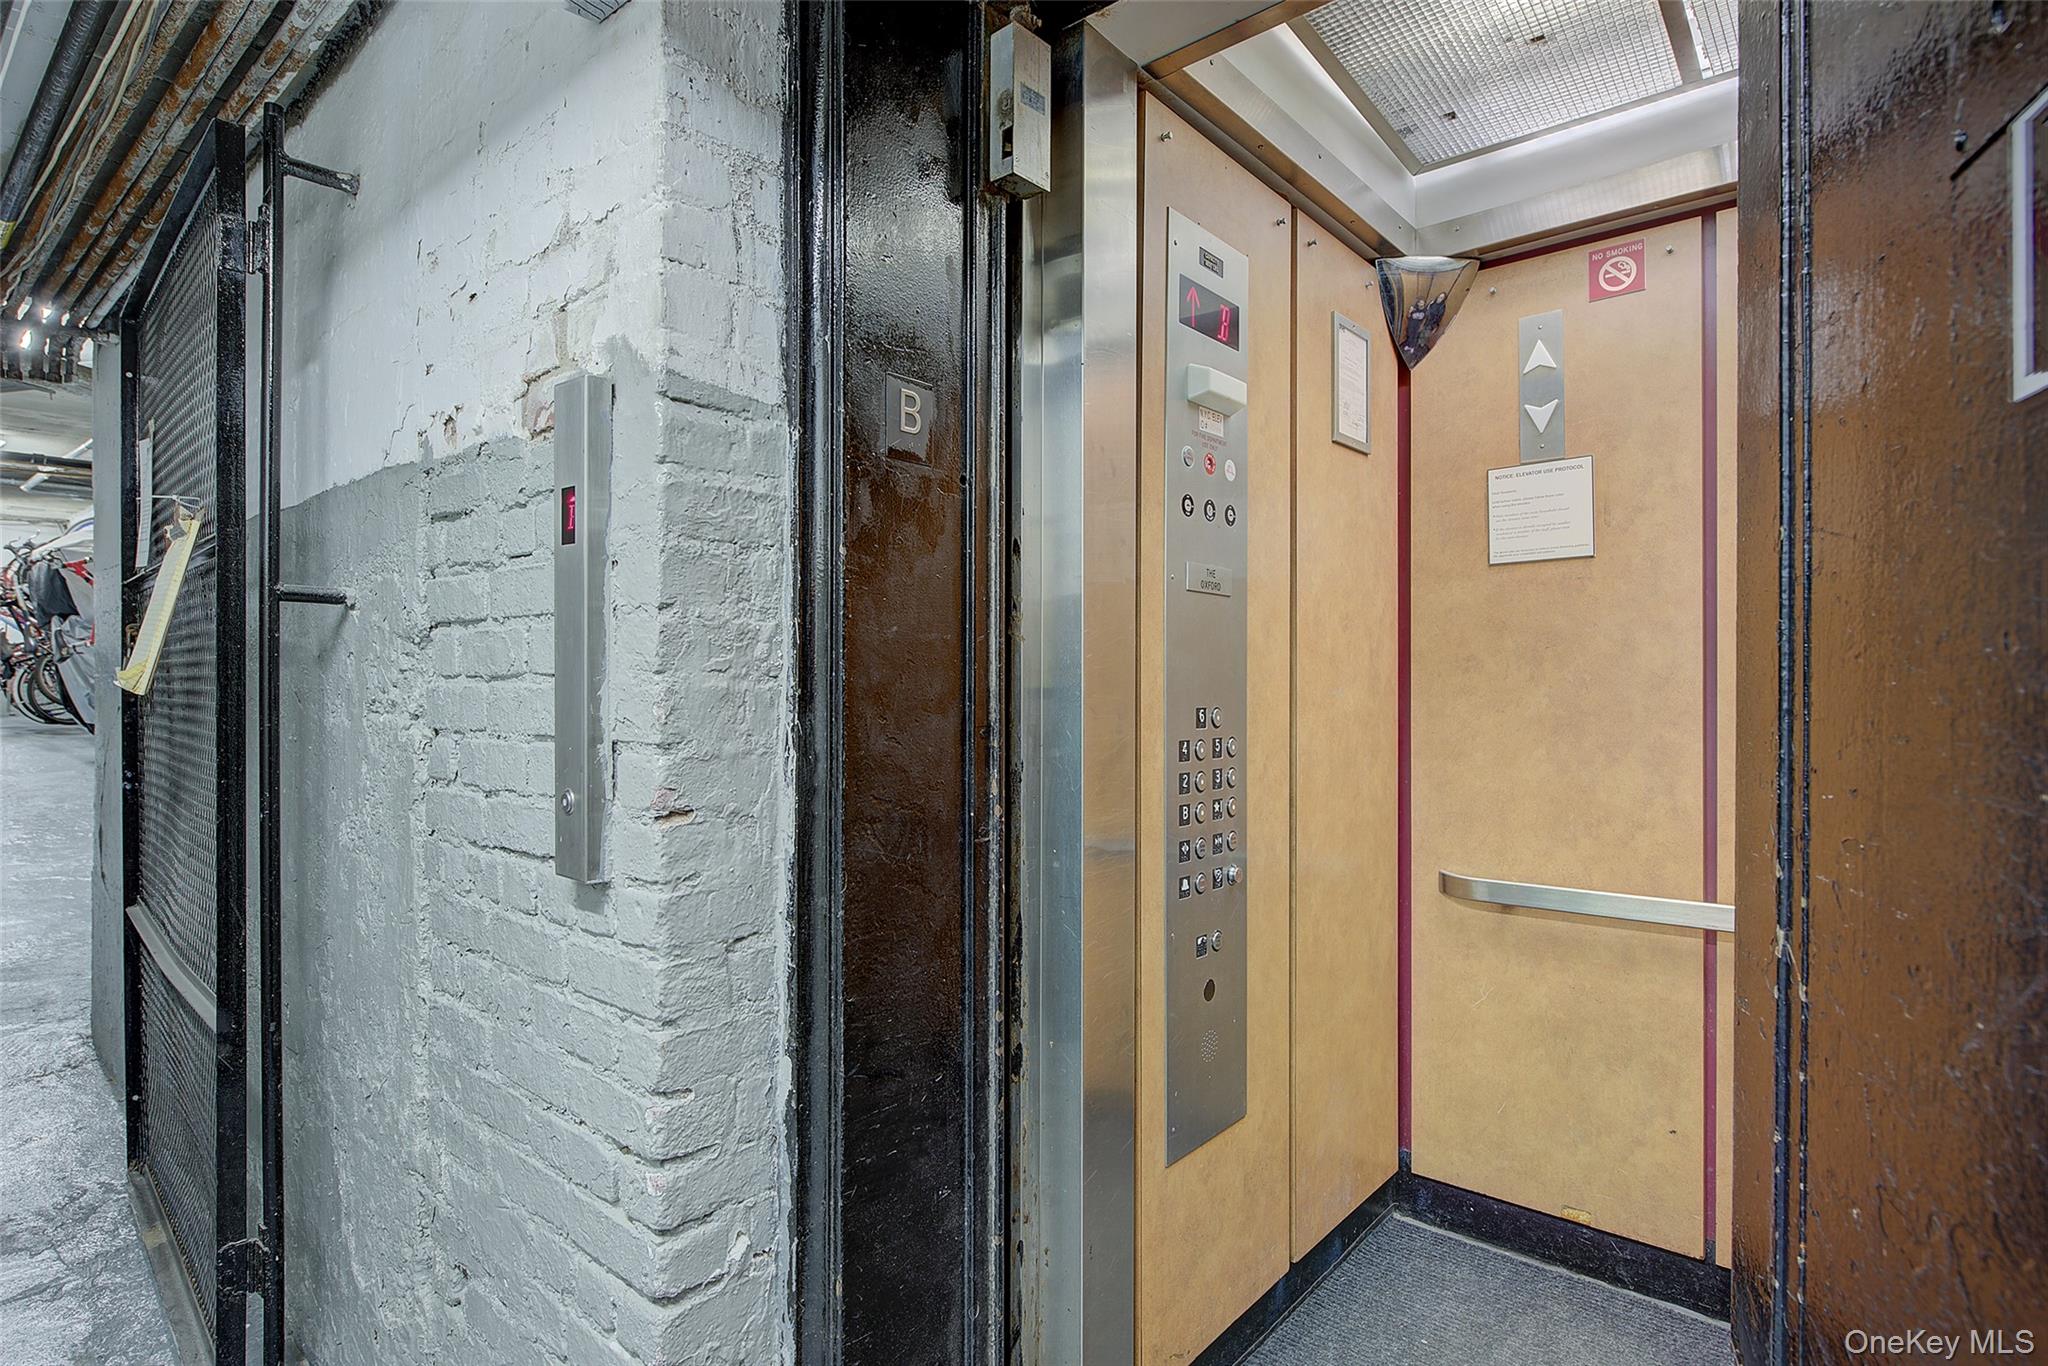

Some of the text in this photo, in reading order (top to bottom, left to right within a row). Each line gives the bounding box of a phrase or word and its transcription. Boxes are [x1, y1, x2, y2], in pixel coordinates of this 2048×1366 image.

[1592, 243, 1643, 261] NO SMOKING
[900, 388, 921, 434] B
[1516, 469, 1542, 478] ELEVATOR
[1554, 464, 1584, 472] PROTOCOL
[1206, 568, 1216, 579] THE
[1200, 579, 1222, 592] OXFORD
[1198, 709, 1205, 723] 6
[1182, 741, 1188, 755] 4
[1215, 739, 1221, 752] 5
[1183, 774, 1189, 788] 2
[1215, 770, 1221, 783] 3
[1183, 806, 1189, 820] B
